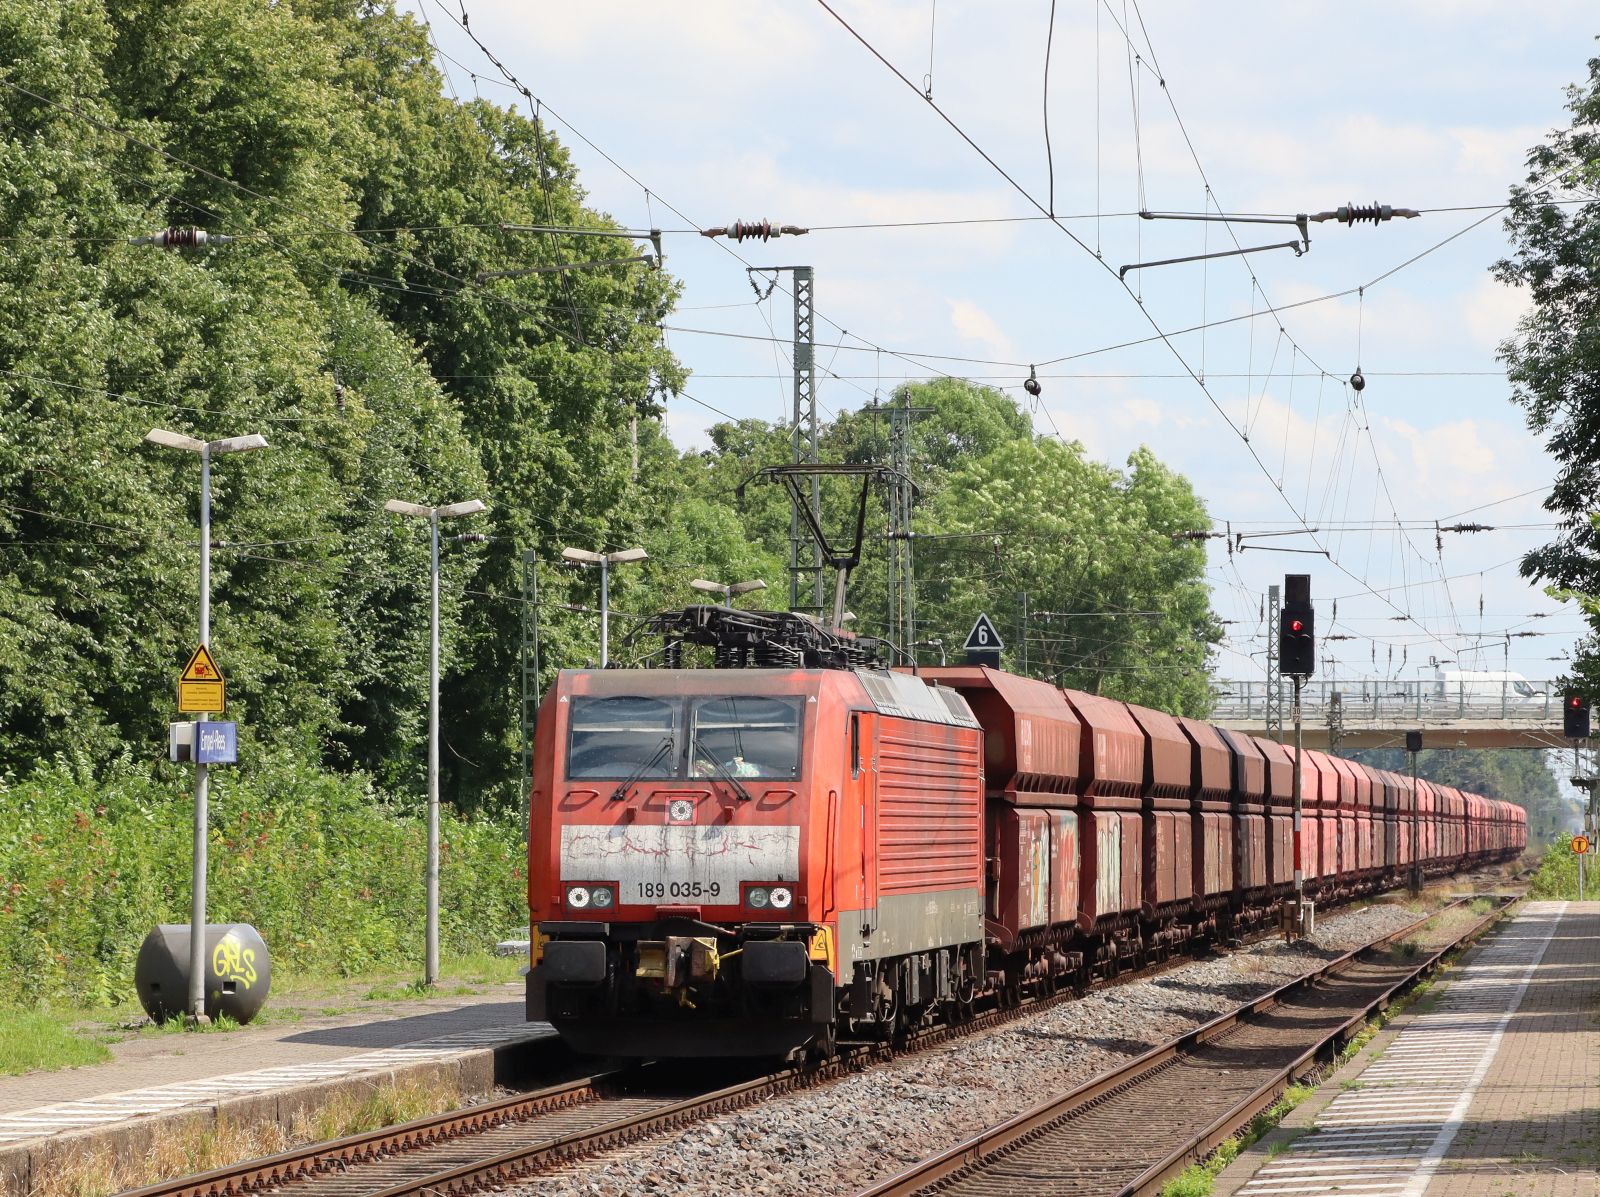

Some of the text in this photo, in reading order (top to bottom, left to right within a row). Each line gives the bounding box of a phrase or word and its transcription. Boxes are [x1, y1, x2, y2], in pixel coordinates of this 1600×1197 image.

[978, 625, 988, 645] 6
[637, 881, 721, 898] 189 035-9
